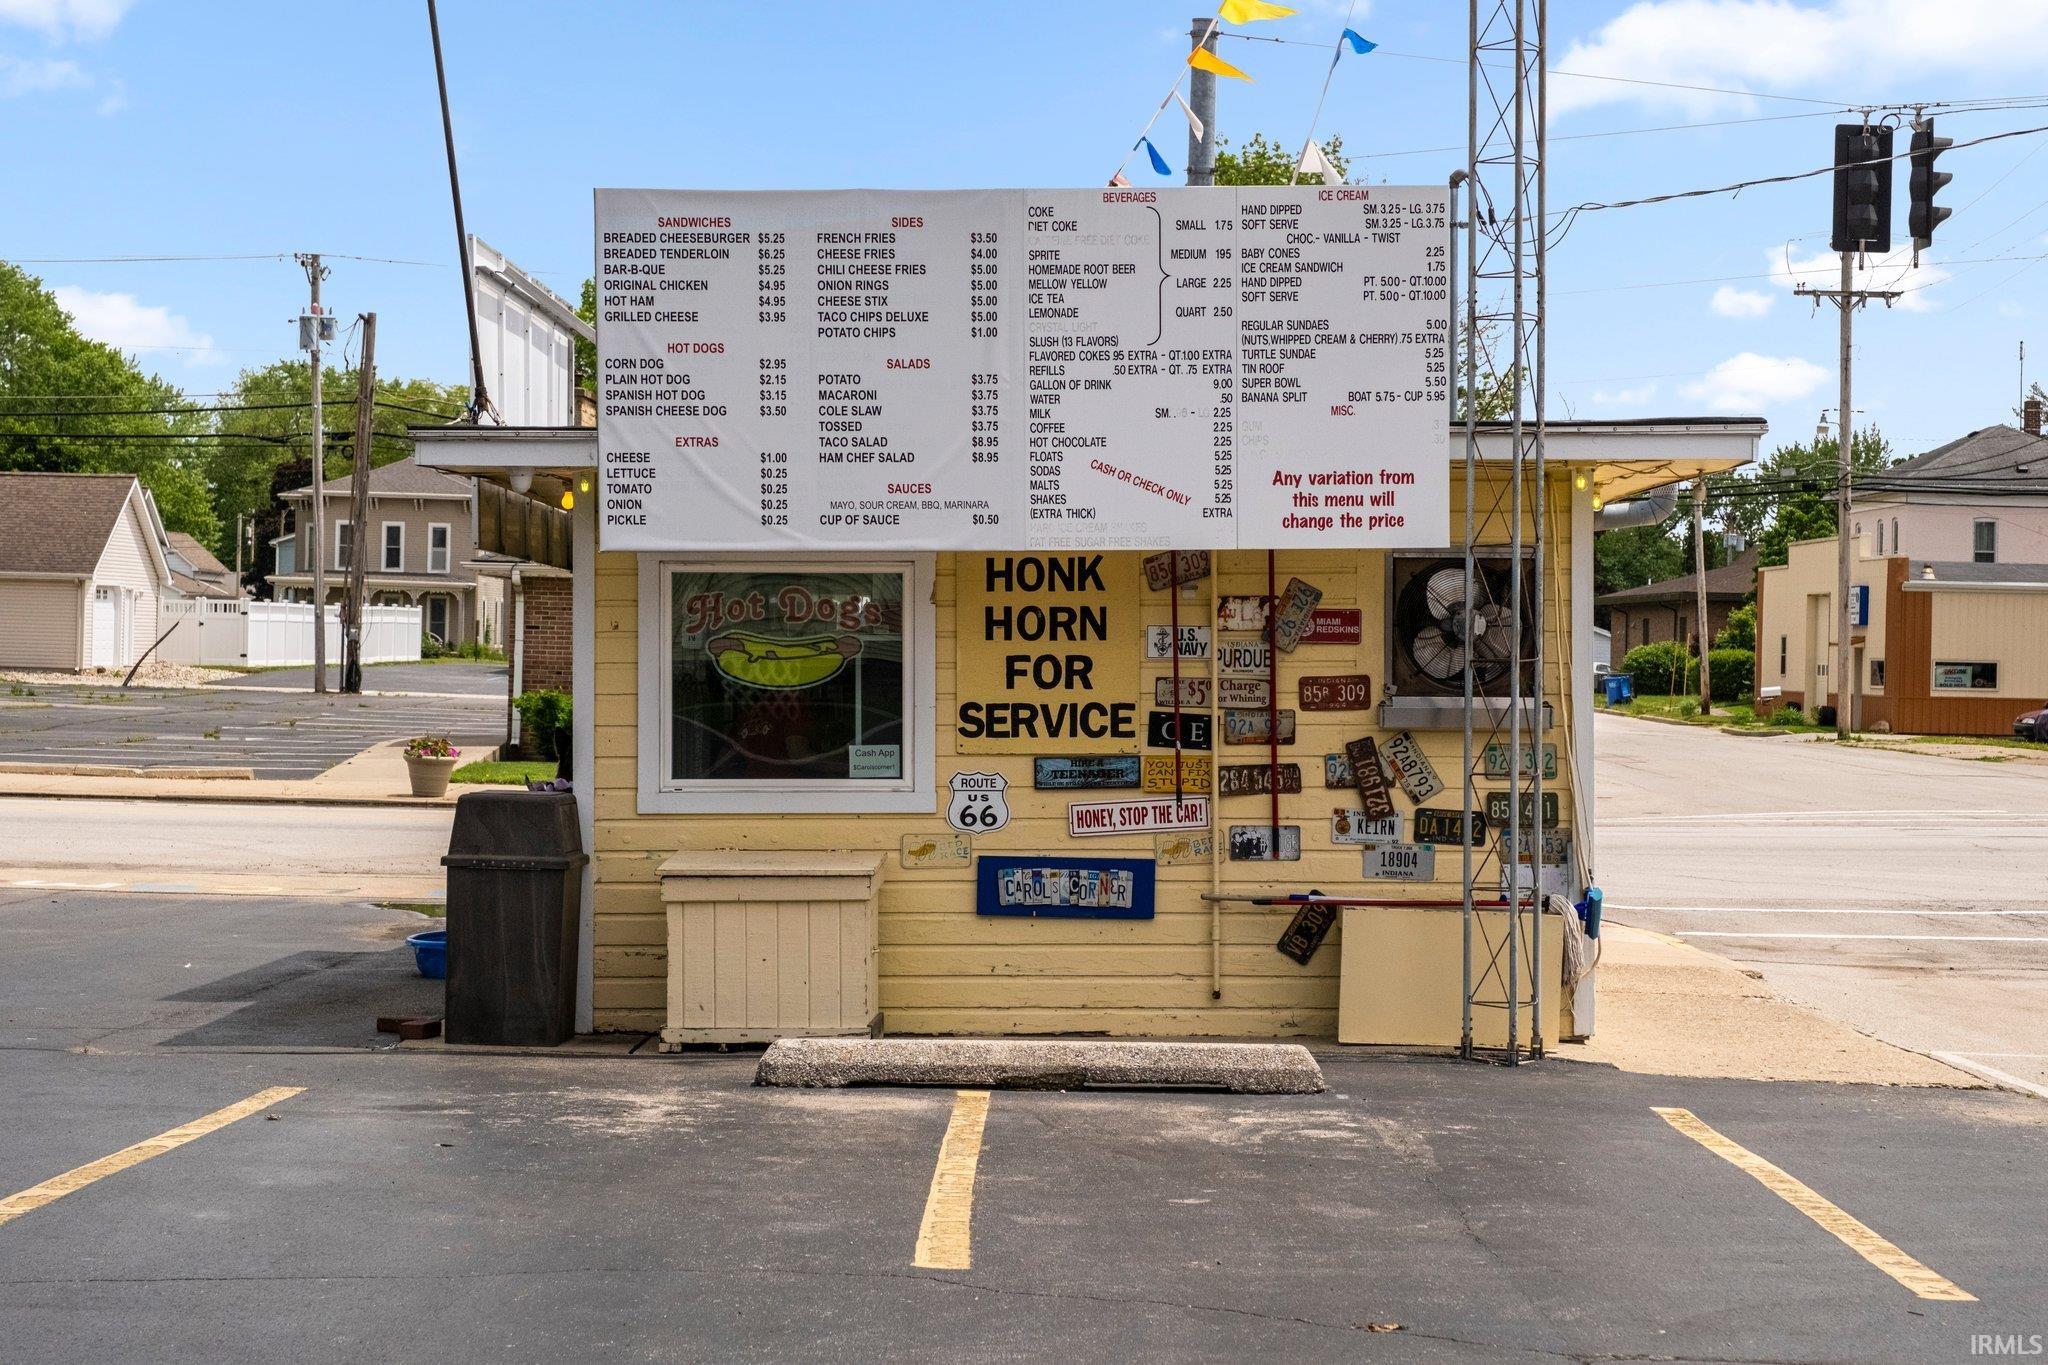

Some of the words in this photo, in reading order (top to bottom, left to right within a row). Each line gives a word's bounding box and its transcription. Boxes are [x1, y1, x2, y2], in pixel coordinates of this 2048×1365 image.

[1103, 192, 1156, 203] BEVERAGES
[1319, 190, 1333, 201] ICE
[1337, 190, 1369, 201] CREAM
[1028, 207, 1054, 217] COKE
[658, 217, 731, 227] SANDWICHES
[892, 217, 923, 228] SIDES
[604, 233, 656, 243] BREADED
[660, 233, 750, 243] CHEESEBURGER
[758, 233, 785, 244] $5.25
[817, 233, 861, 243] FRENCH
[865, 233, 895, 243] FRIES
[971, 232, 997, 244] $3.50
[1029, 250, 1060, 260] SPRITE
[1241, 248, 1265, 259] BABY
[1268, 248, 1300, 258] CONES
[1426, 246, 1444, 257] 2.25
[604, 264, 665, 275] BAR-B-QUE
[759, 264, 785, 276] $5.25
[817, 264, 845, 275] CHILI
[848, 264, 892, 275] CHEESE
[895, 264, 926, 275] FRIES
[971, 264, 997, 276] $5.00
[1029, 264, 1081, 275] HOMEMADE
[1084, 264, 1109, 275] ROOT
[1112, 264, 1135, 274] BEER
[1242, 262, 1256, 273] ICE
[1259, 262, 1291, 273] CREAM
[1295, 262, 1343, 273] SANDWICH
[604, 280, 657, 290] ORIGINAL
[659, 280, 708, 290] CHICKEN
[759, 280, 785, 291] $4.95
[1029, 279, 1067, 289] MELLOW
[1071, 278, 1107, 289] YELLOW
[1177, 278, 1206, 288] LARGE
[1213, 278, 1231, 288] 2.25
[605, 296, 627, 306] HOT
[630, 296, 654, 306] HAM
[759, 296, 785, 307] $4.95
[1029, 293, 1043, 304] ICE
[1047, 293, 1064, 303] TEA
[1029, 307, 1079, 318] LEMONADE
[1030, 336, 1059, 347] SLUSH
[1062, 335, 1073, 347] (13
[1076, 335, 1119, 347] FLAVORS)
[668, 343, 690, 353] HOT
[693, 343, 724, 353] DOGS
[1242, 349, 1276, 359] TURTLE
[1280, 349, 1316, 359] SUNDAE
[605, 358, 636, 369] CORN
[640, 359, 664, 369] DOG
[760, 358, 786, 370] $2.95
[887, 359, 930, 369] SALADS
[1030, 380, 1066, 390] GALLON
[1069, 379, 1081, 390] OF
[1084, 380, 1112, 390] DRINK
[1213, 378, 1233, 389] 9.00
[819, 390, 877, 400] MACARONI
[972, 389, 998, 401] $3.75
[1242, 392, 1279, 402] BANANA
[1283, 391, 1307, 402] SPLIT
[1331, 405, 1355, 416] MISC.
[676, 437, 718, 447] EXTRAS
[607, 468, 656, 478] LETTUCE
[761, 468, 787, 479] $0.25
[1272, 470, 1302, 488] Any
[1309, 471, 1373, 485] variation
[1379, 469, 1414, 484] from
[1090, 459, 1115, 477] CASH
[1117, 470, 1132, 483] OR
[1133, 476, 1165, 496] CHECK
[1166, 489, 1192, 506] ONLY
[888, 483, 931, 494] SAUCES
[1292, 492, 1318, 507] this
[1325, 495, 1364, 507] menu
[1370, 491, 1394, 506] will
[830, 501, 857, 511] MAYO,
[860, 501, 884, 509] SOUR
[886, 501, 919, 510] CREAM,
[921, 500, 942, 510] BBQ,
[944, 501, 989, 509] MARINARA
[608, 515, 646, 525] PICKLE
[761, 515, 788, 526] $0.25
[820, 515, 842, 526] CUP
[845, 515, 859, 525] OF
[863, 515, 900, 525] SAUCE
[973, 514, 999, 526] $0.50
[1282, 513, 1333, 531] change
[1340, 512, 1362, 528] the
[1369, 513, 1404, 530] price
[985, 555, 1105, 592] HONK
[685, 590, 765, 634] Hot
[778, 585, 882, 631] Dogs
[984, 606, 1107, 641] HORN
[1316, 626, 1360, 634] REDSKINS
[1005, 654, 1093, 690] FOR
[1220, 680, 1261, 694] Charge
[1338, 684, 1365, 702] 309
[1229, 694, 1267, 705] Whining
[957, 702, 1136, 738] SERVICE
[855, 749, 876, 757] Cash
[878, 749, 895, 758] App
[961, 778, 997, 788] ROUTE
[960, 805, 998, 827] 66
[1077, 808, 1116, 830] HONEY,
[1119, 806, 1149, 826] STOP
[1152, 805, 1173, 824] THE
[1176, 802, 1204, 823] CAR!
[1357, 819, 1395, 835] KEIRN
[1381, 852, 1418, 868] 18904
